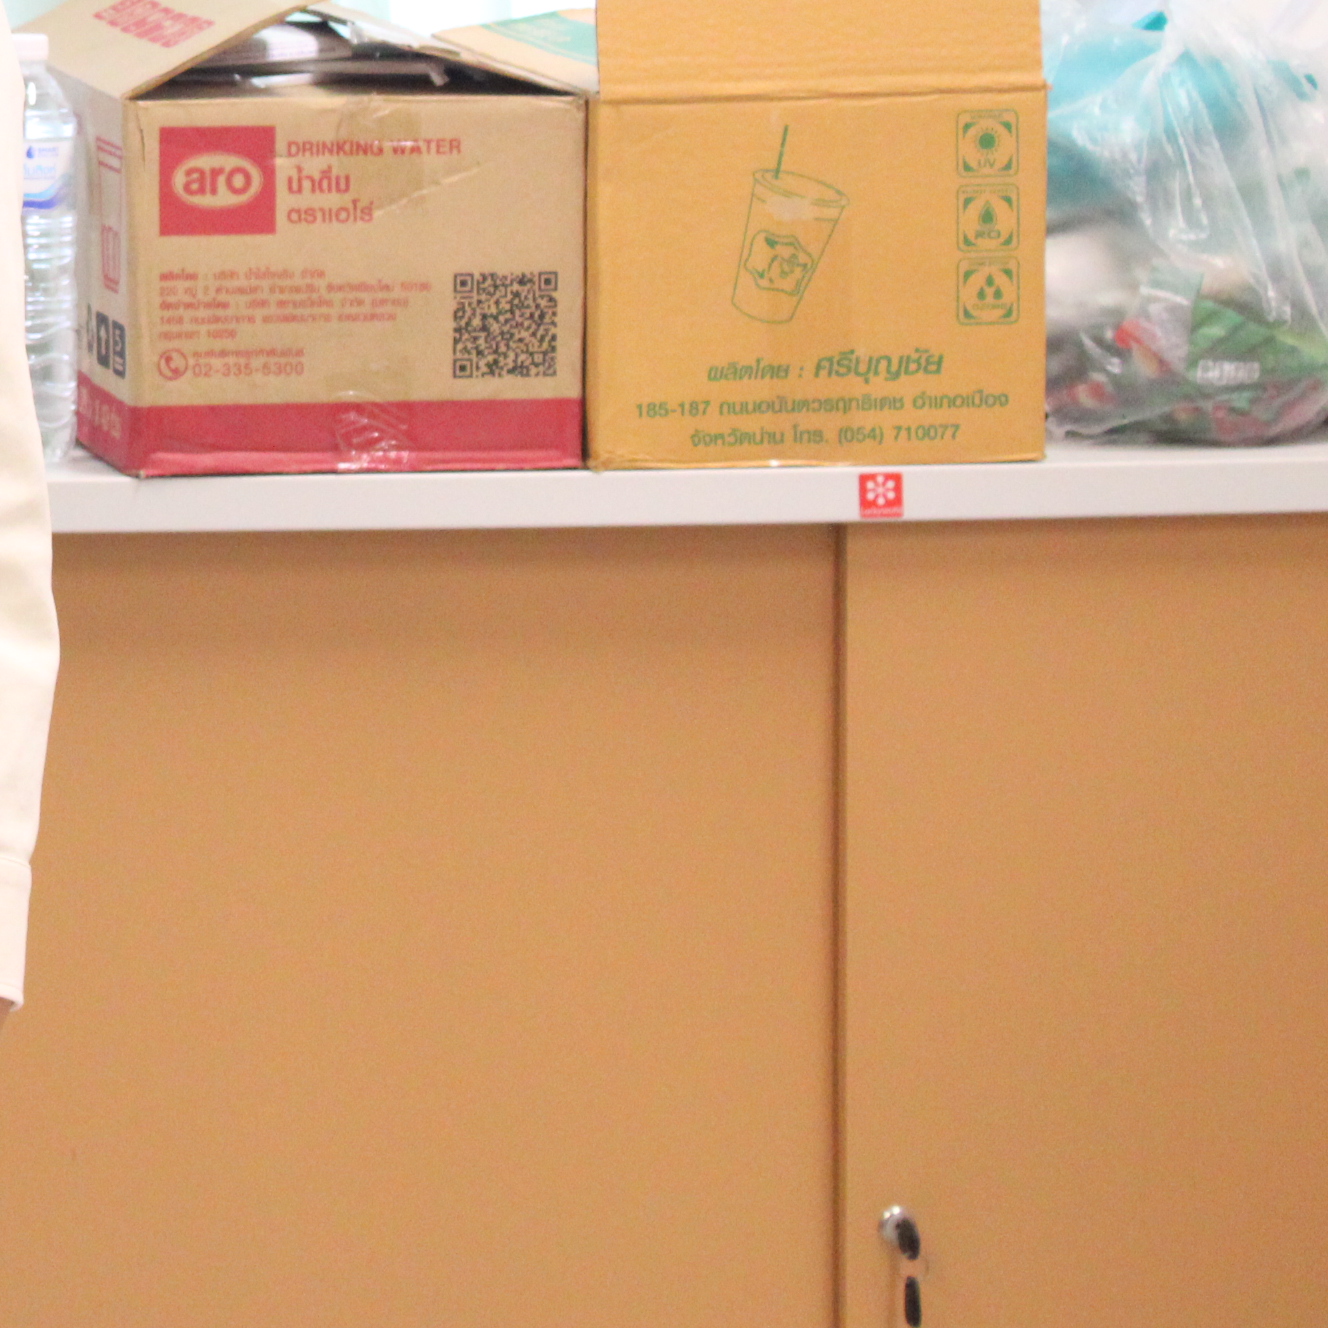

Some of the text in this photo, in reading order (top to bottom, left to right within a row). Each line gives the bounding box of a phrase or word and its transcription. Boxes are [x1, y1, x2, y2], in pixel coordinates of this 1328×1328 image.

[287, 138, 461, 157] DRINKING WATER
[182, 165, 252, 196] aro
[287, 164, 351, 194] น้ำดื่ม
[287, 198, 374, 224] ตราเอโร่
[707, 357, 790, 383] ผลิตโดย
[814, 348, 944, 384] ศรีบุญชัย
[635, 400, 711, 419] 185-187
[912, 389, 1010, 411] อำเภอเมือง
[690, 423, 961, 448] จังหวัดน่าน โทร. (054) 710077
